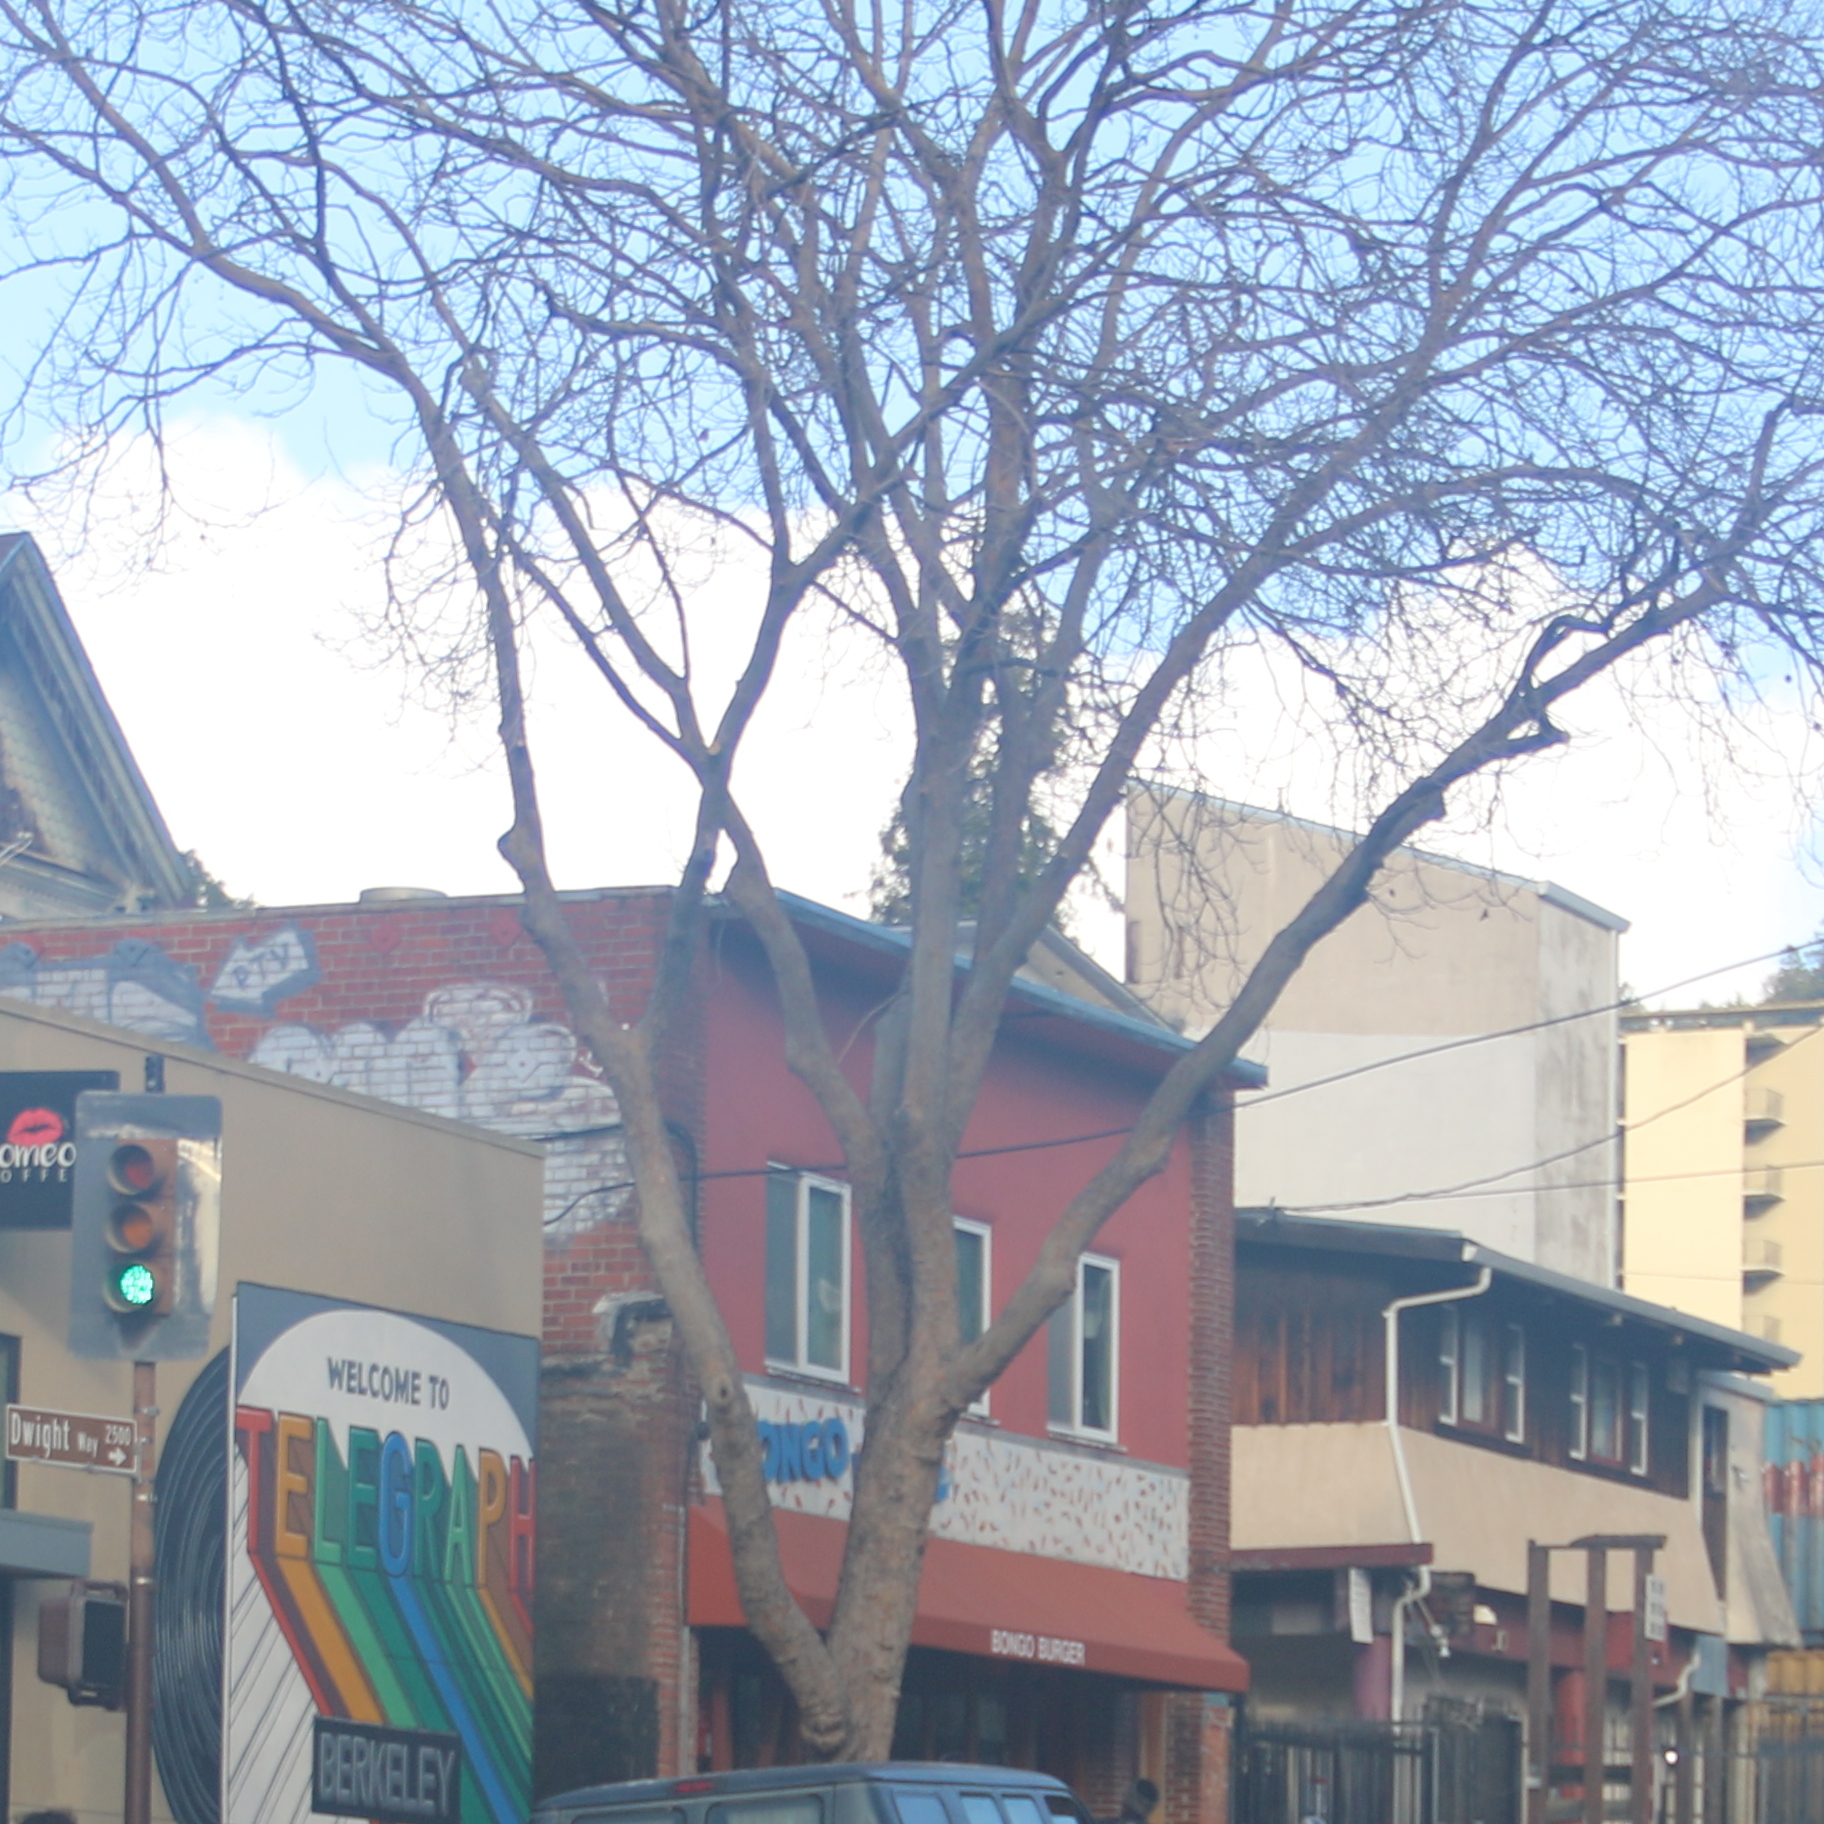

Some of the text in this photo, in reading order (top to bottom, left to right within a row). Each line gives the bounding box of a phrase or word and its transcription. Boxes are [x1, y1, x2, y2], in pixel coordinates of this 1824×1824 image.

[327, 1356, 451, 1409] WELCOME TO
[8, 1412, 132, 1458] Dwight Way 2500
[758, 1417, 849, 1483] ONGO
[236, 1405, 538, 1593] TELEGRAPH
[991, 1629, 1086, 1667] BONGO BURGER
[319, 1730, 458, 1818] BERKELEY
